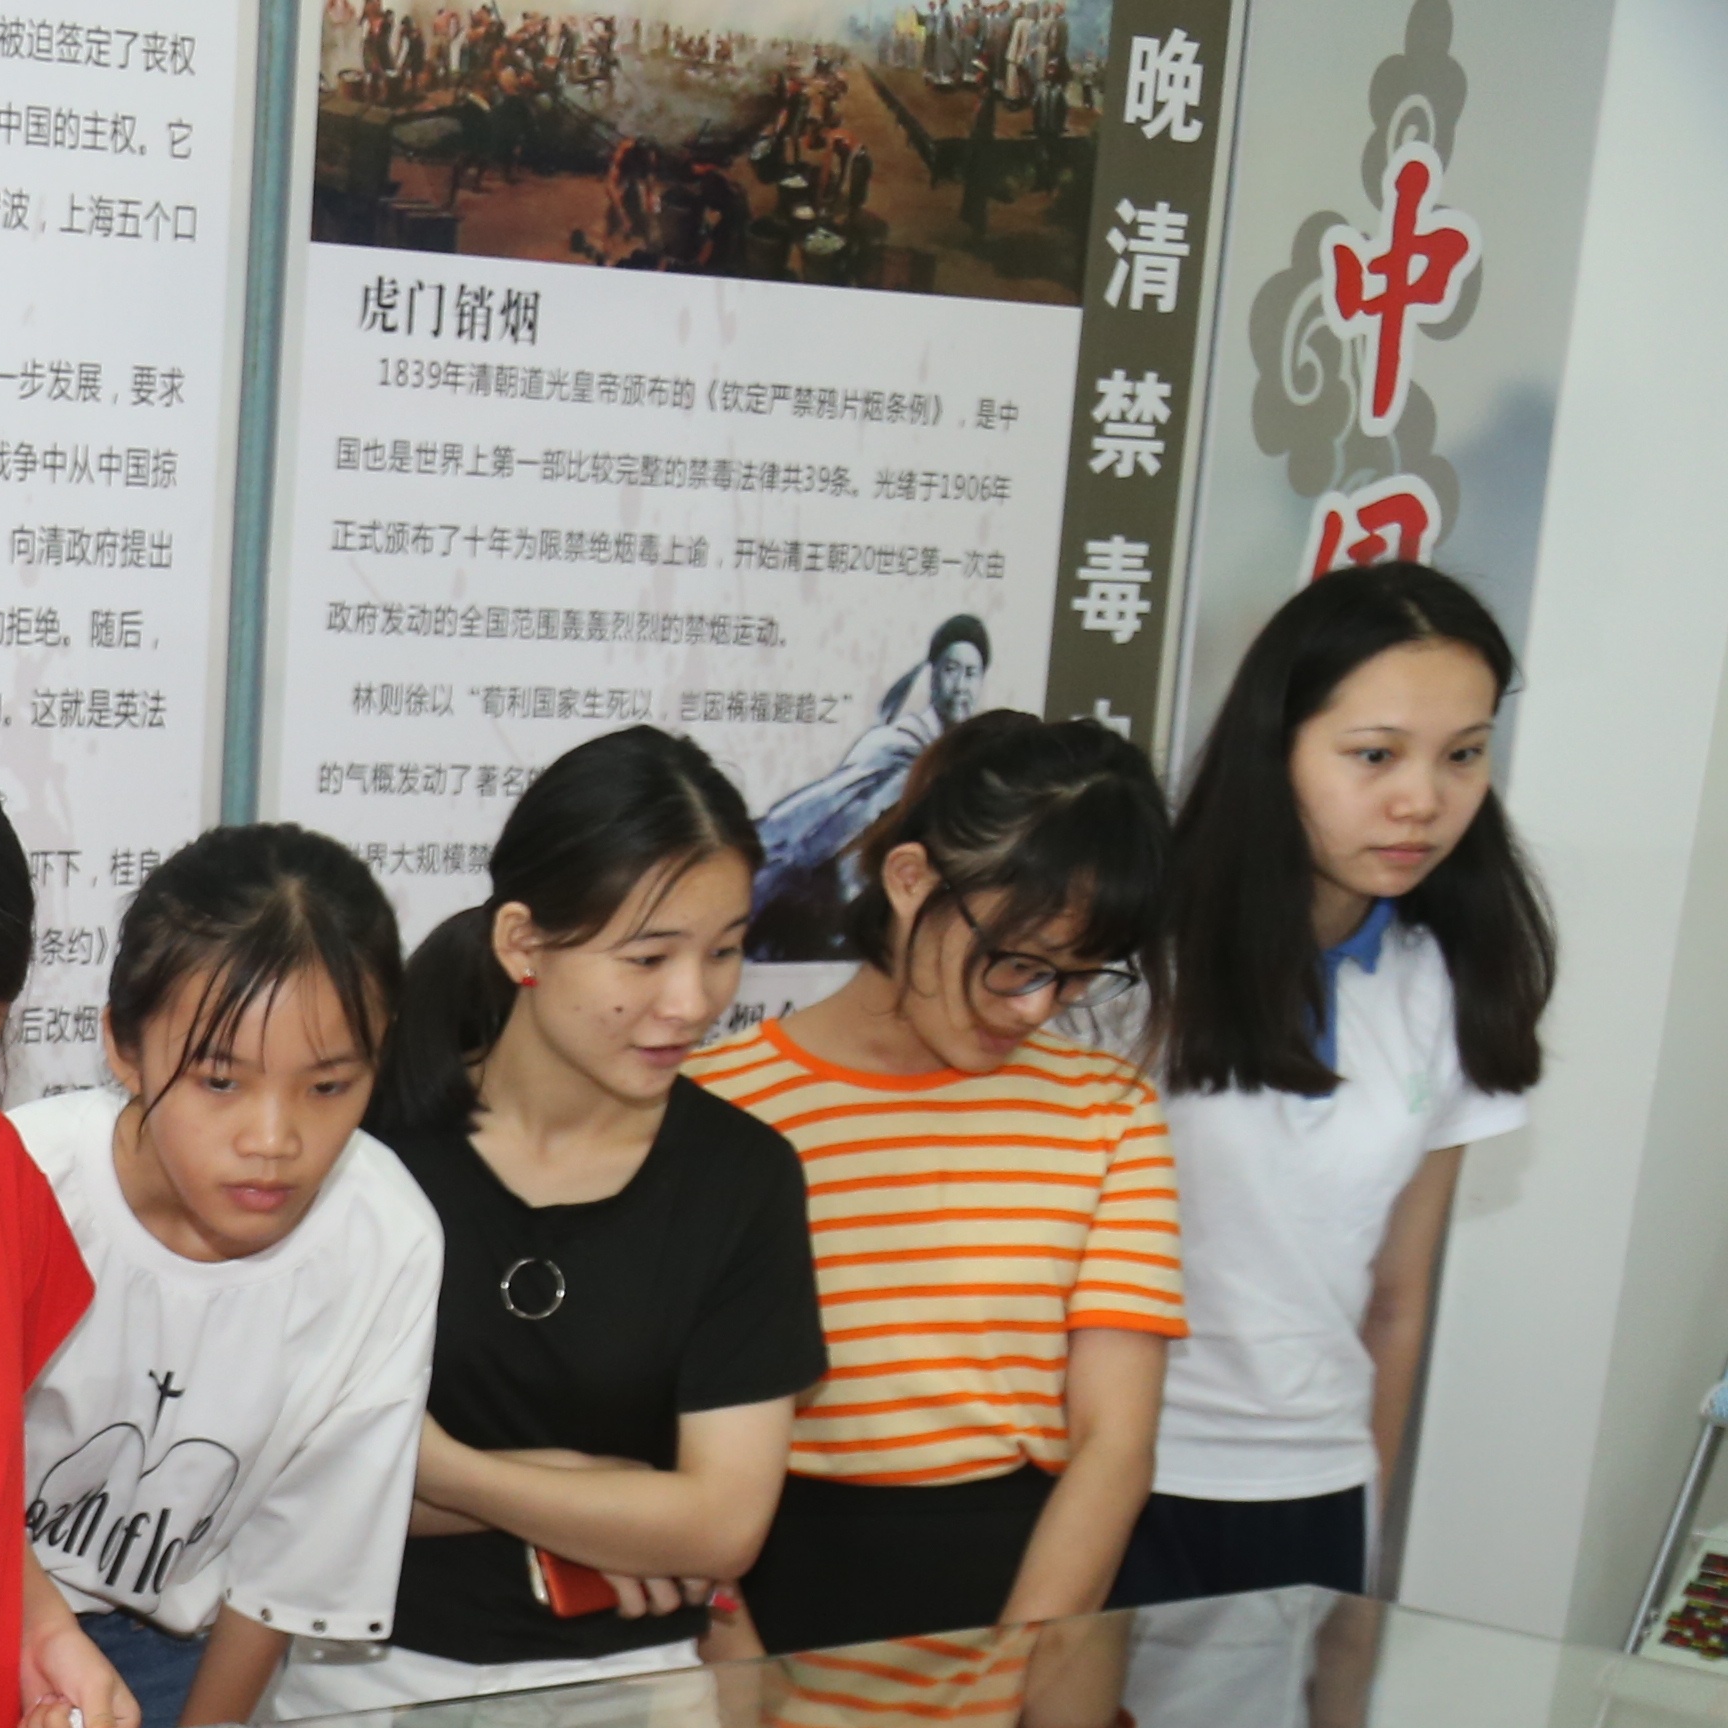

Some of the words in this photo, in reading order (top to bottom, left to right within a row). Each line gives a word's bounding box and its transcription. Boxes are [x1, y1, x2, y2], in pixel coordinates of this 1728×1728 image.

[358, 275, 542, 346] 虎门销烟
[1070, 28, 1205, 741] 晚清禁毒
[31, 927, 110, 966] 条约》
